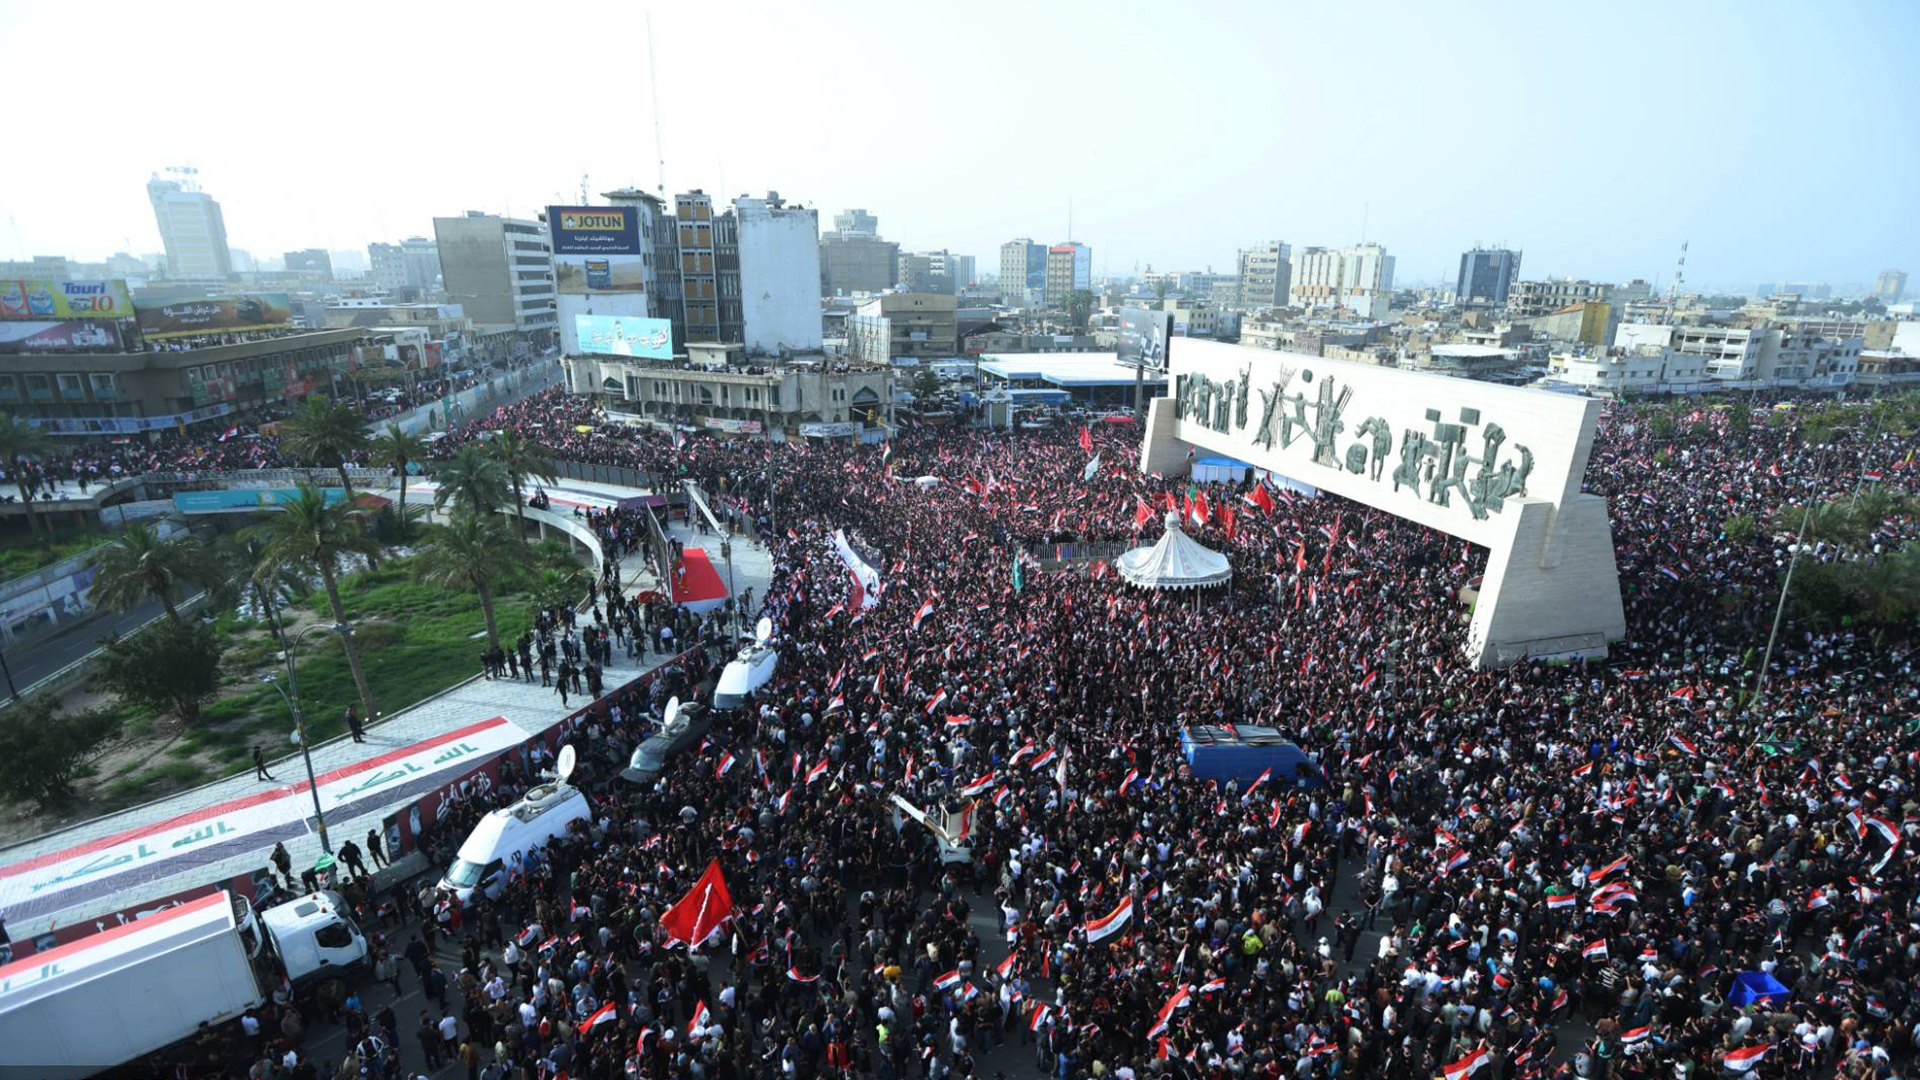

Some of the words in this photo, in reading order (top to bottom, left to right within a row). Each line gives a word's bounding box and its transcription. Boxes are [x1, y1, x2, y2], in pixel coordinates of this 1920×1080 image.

[578, 215, 622, 227] JOTUN
[62, 282, 105, 294] Touri
[90, 296, 113, 312] 10
[433, 742, 479, 765] الله
[334, 762, 425, 801] اكبر
[171, 821, 236, 849] الله
